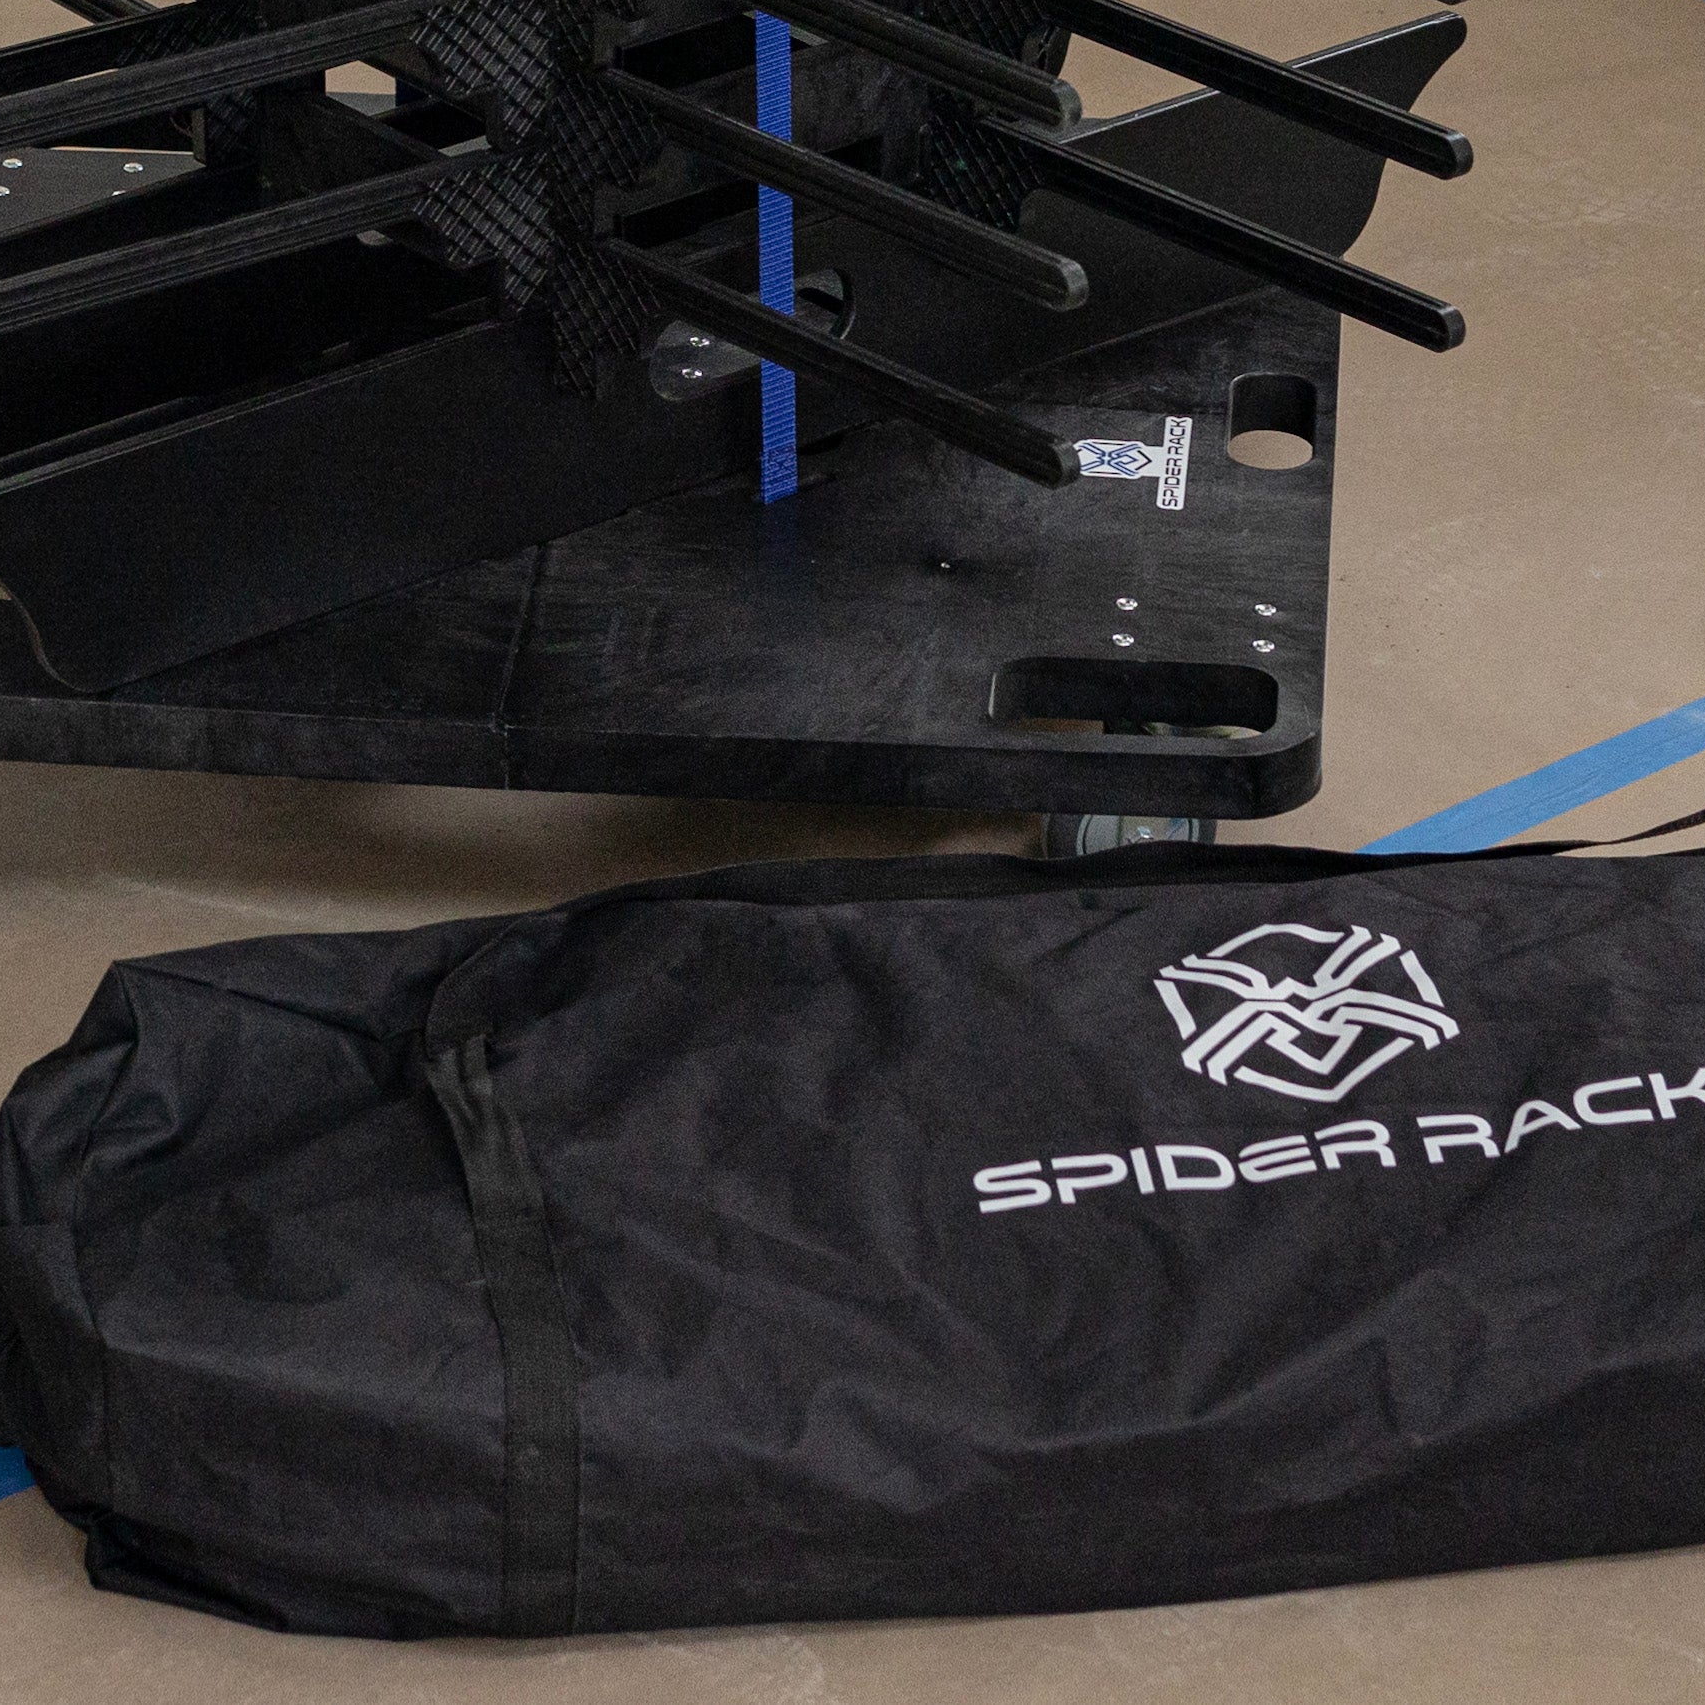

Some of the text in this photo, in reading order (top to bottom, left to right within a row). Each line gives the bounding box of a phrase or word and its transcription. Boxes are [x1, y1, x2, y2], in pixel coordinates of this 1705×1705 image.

[1163, 419, 1186, 507] SPIDER RACK
[973, 1120, 1397, 1213] SPIDER
